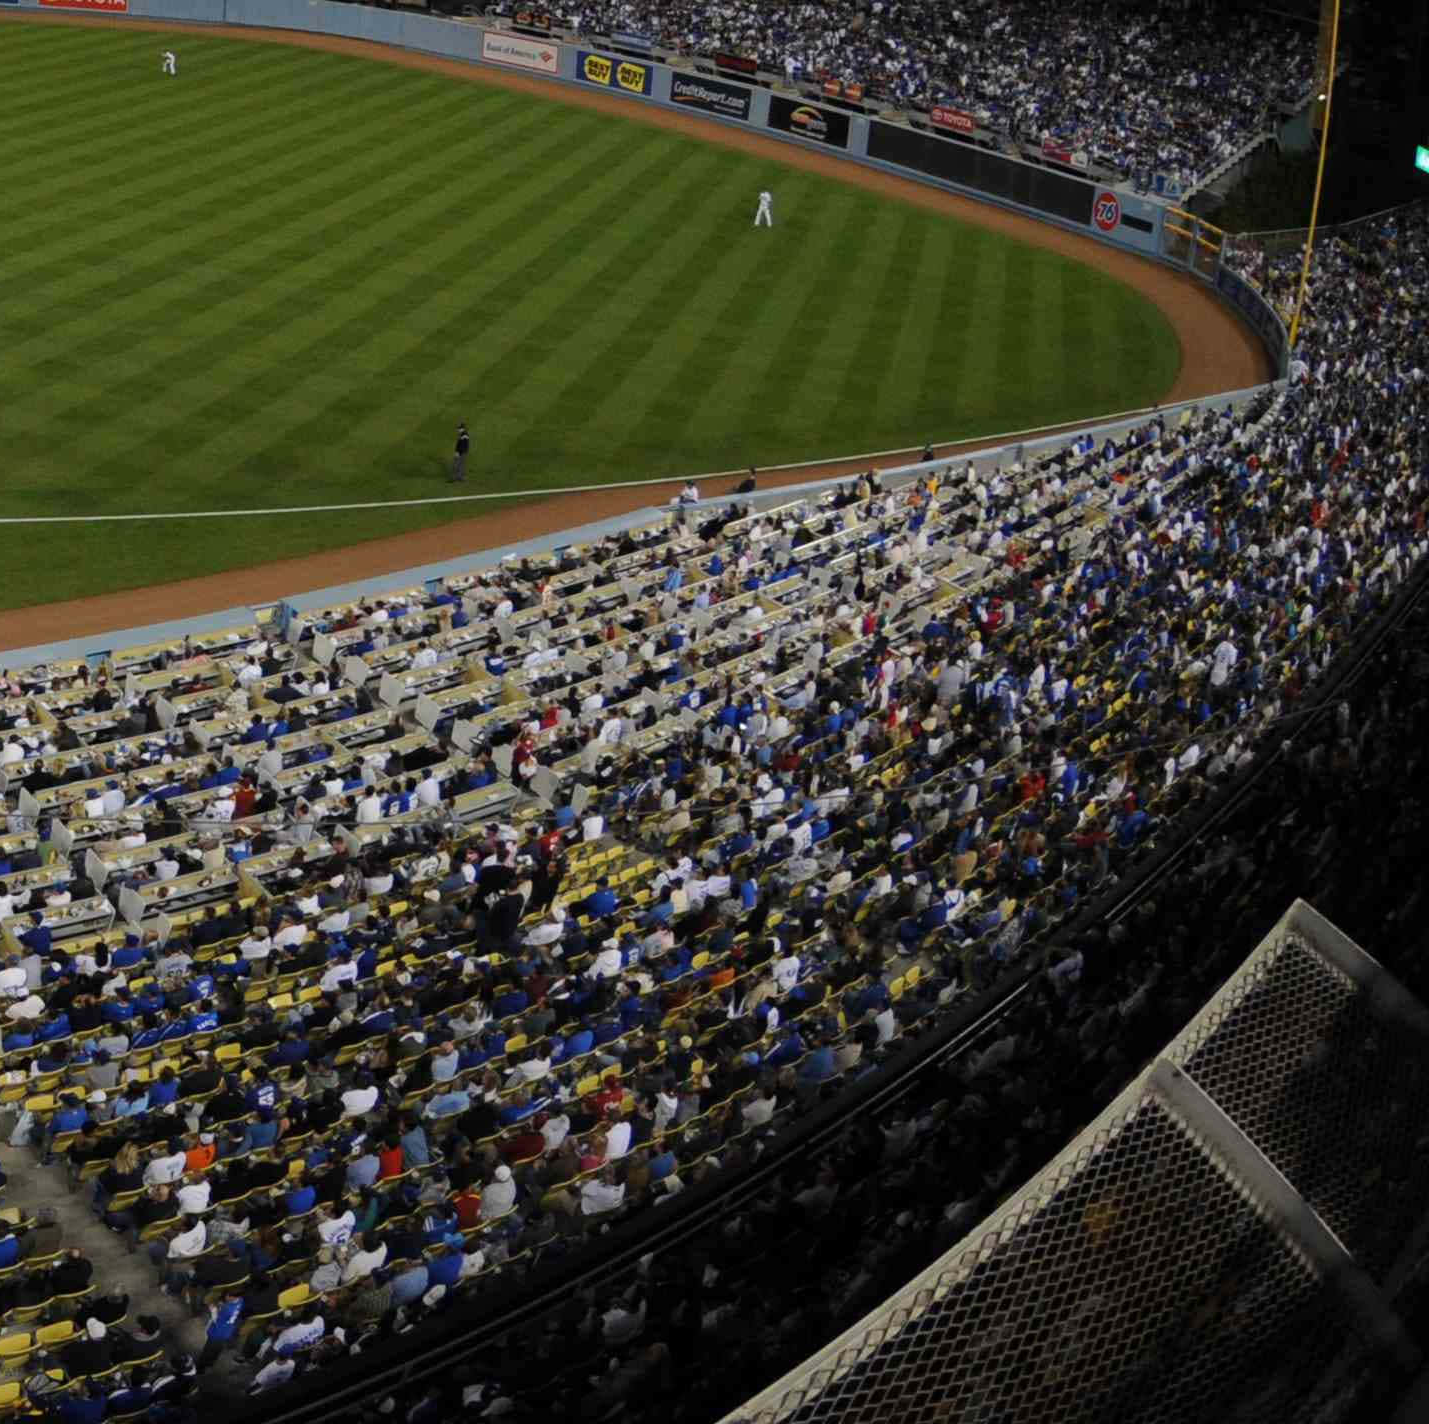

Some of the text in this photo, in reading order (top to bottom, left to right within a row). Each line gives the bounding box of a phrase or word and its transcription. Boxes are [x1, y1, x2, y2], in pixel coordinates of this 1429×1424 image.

[588, 60, 610, 73] BEST
[620, 66, 644, 79] BEST
[1098, 203, 1117, 221] 76
